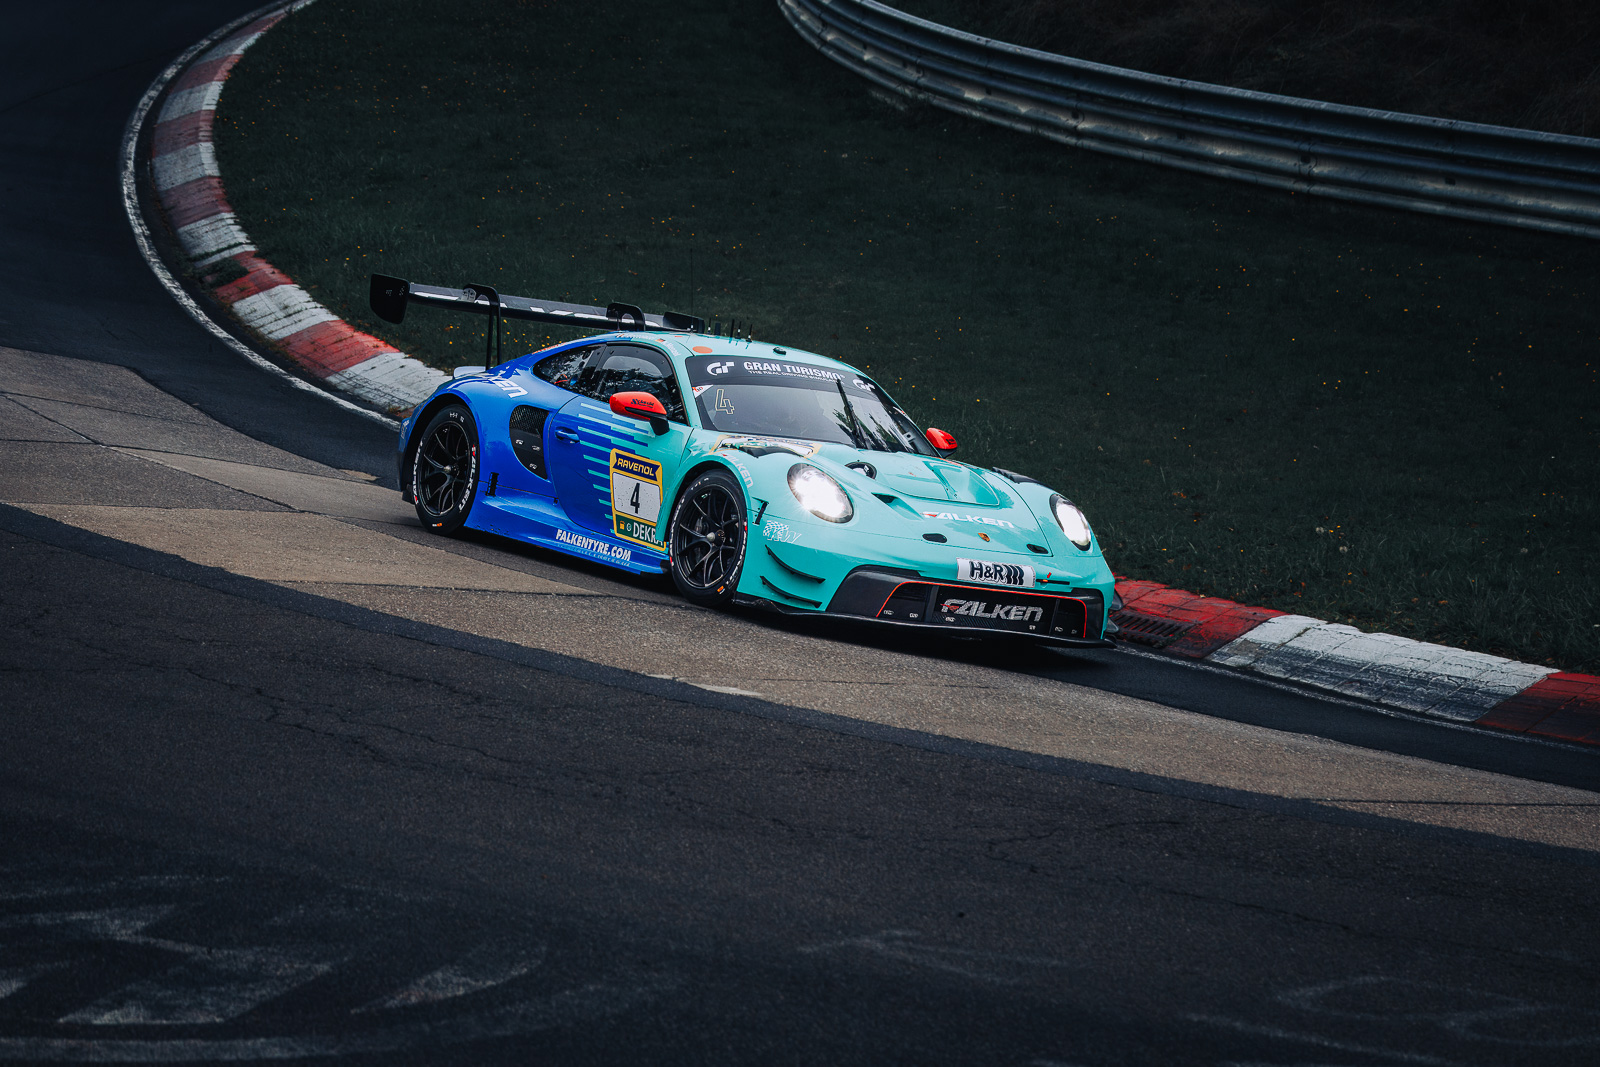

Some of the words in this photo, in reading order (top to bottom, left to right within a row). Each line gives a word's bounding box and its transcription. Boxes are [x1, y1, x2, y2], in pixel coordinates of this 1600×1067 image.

[743, 361, 781, 372] GRAN
[783, 364, 842, 380] TURISMO
[714, 388, 735, 415] 4
[617, 457, 655, 477] RAVENOL
[630, 482, 641, 515] 4
[919, 511, 1015, 529] FALKEN
[555, 528, 632, 562] FALKENTYRE.COM
[940, 598, 1044, 622] FALKEN
